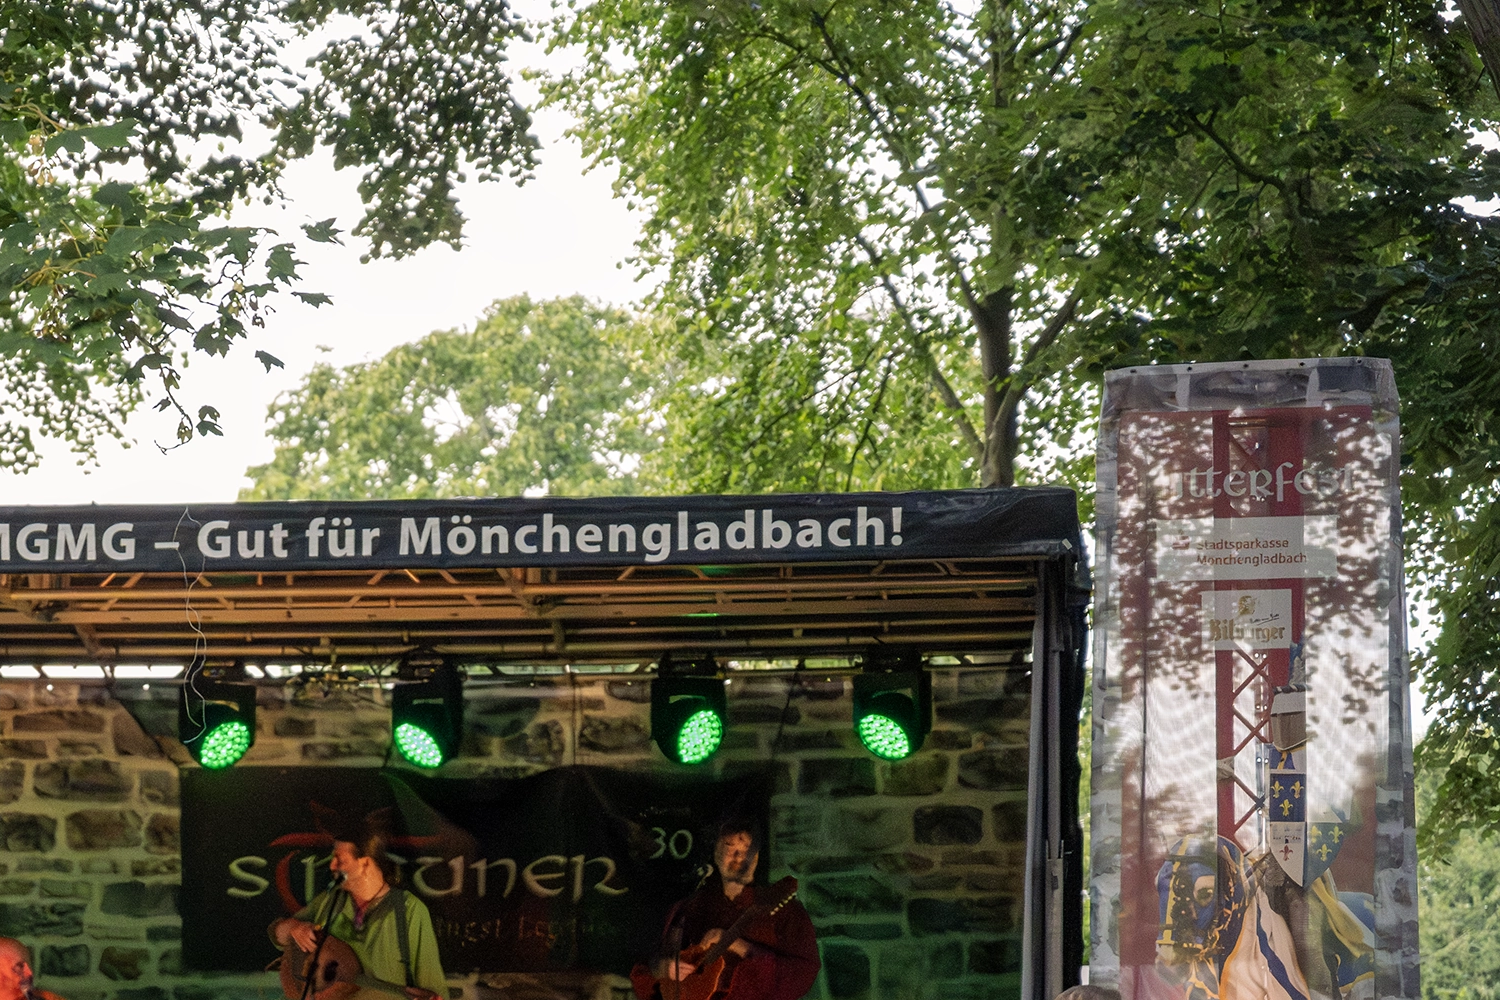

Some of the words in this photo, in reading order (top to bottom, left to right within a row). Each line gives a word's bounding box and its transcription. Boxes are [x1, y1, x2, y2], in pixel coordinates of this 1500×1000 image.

[197, 519, 288, 560] Gut
[305, 515, 381, 558] für
[400, 507, 904, 562] Mönchengladbach!
[649, 826, 694, 860] 30
